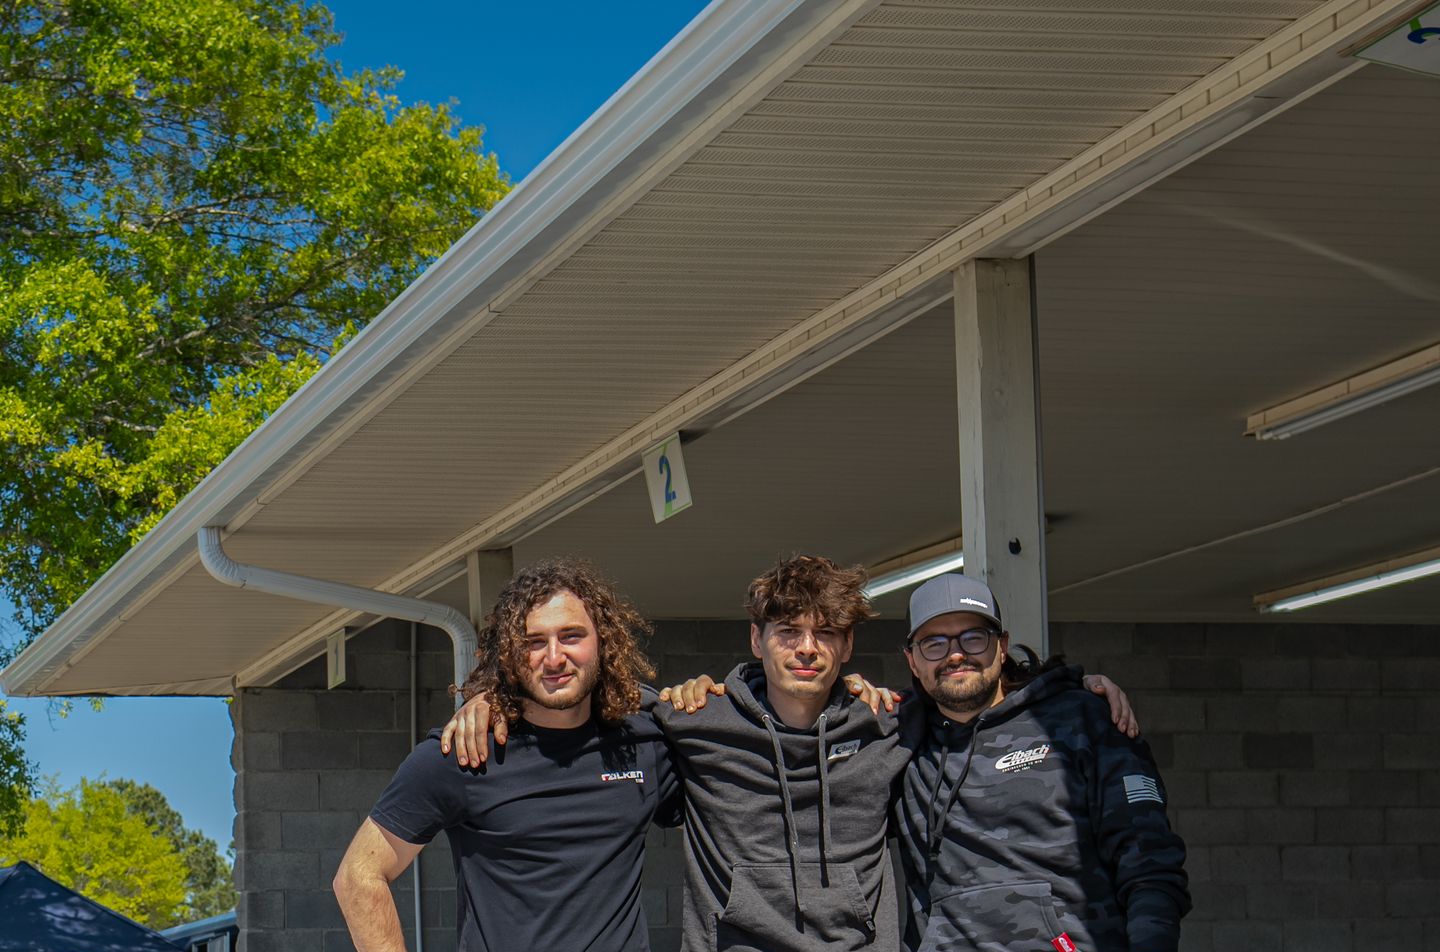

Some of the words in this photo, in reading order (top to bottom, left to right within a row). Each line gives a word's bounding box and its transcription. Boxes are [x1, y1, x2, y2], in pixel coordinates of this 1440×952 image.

[658, 454, 677, 504] 2
[995, 744, 1050, 769] Eibach
[601, 770, 644, 781] FALKEN
